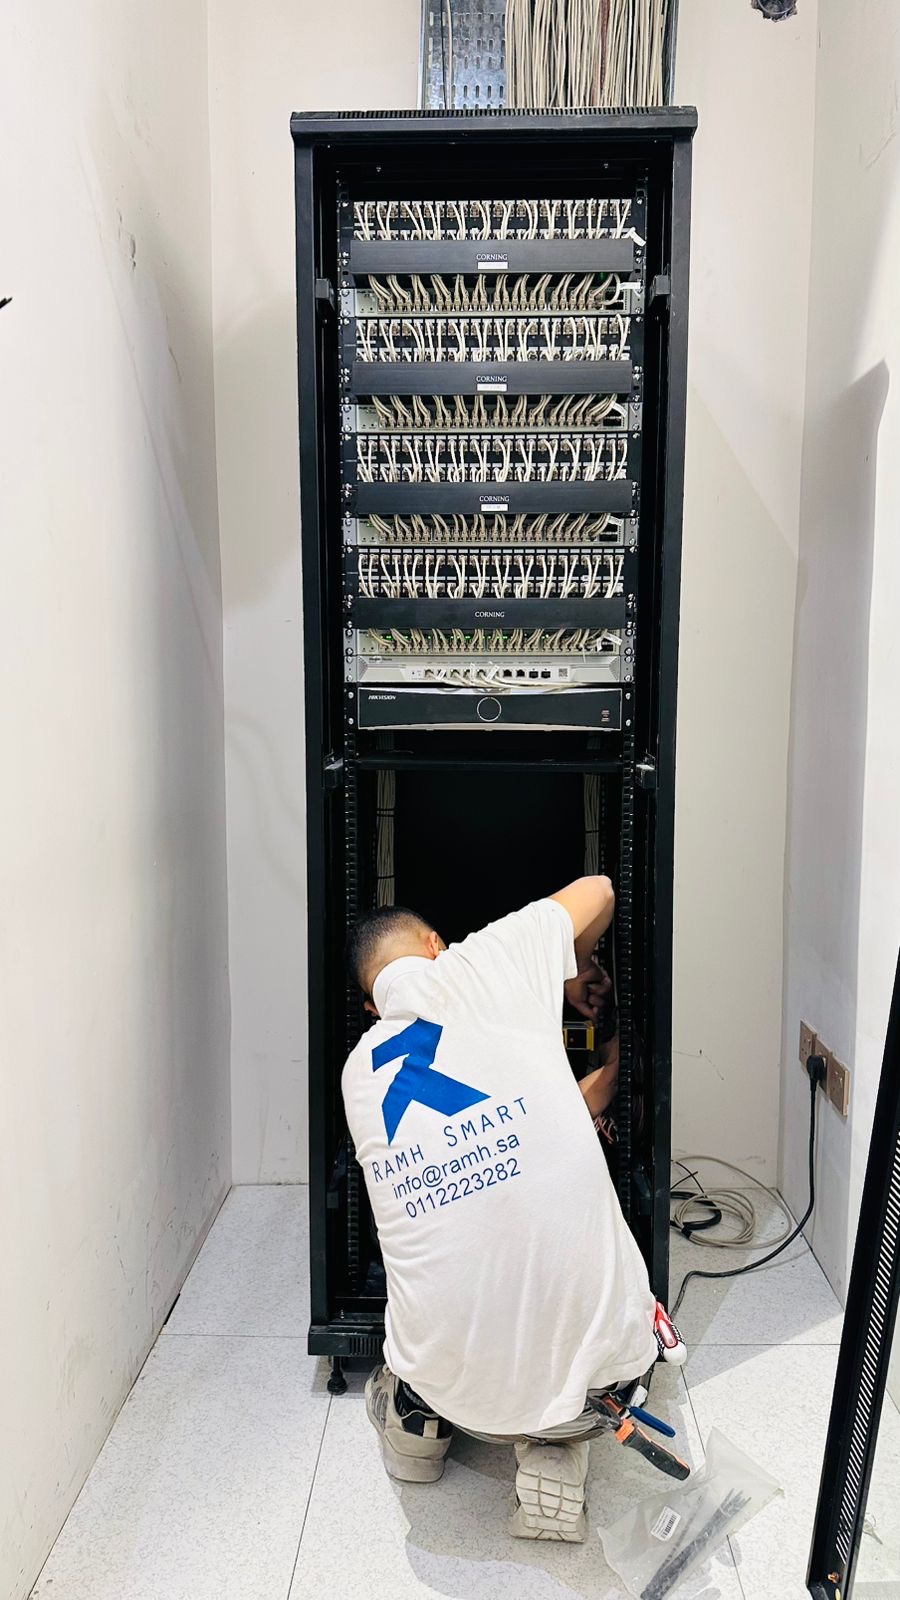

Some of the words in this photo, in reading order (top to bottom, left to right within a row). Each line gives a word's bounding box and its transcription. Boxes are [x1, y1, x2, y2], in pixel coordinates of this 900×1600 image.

[476, 253, 508, 261] CORNING
[372, 1144, 425, 1182] RAMH
[443, 1097, 527, 1147] SMART
[392, 1134, 520, 1199] info@ramh.sa
[406, 1158, 521, 1218] 0112223282
